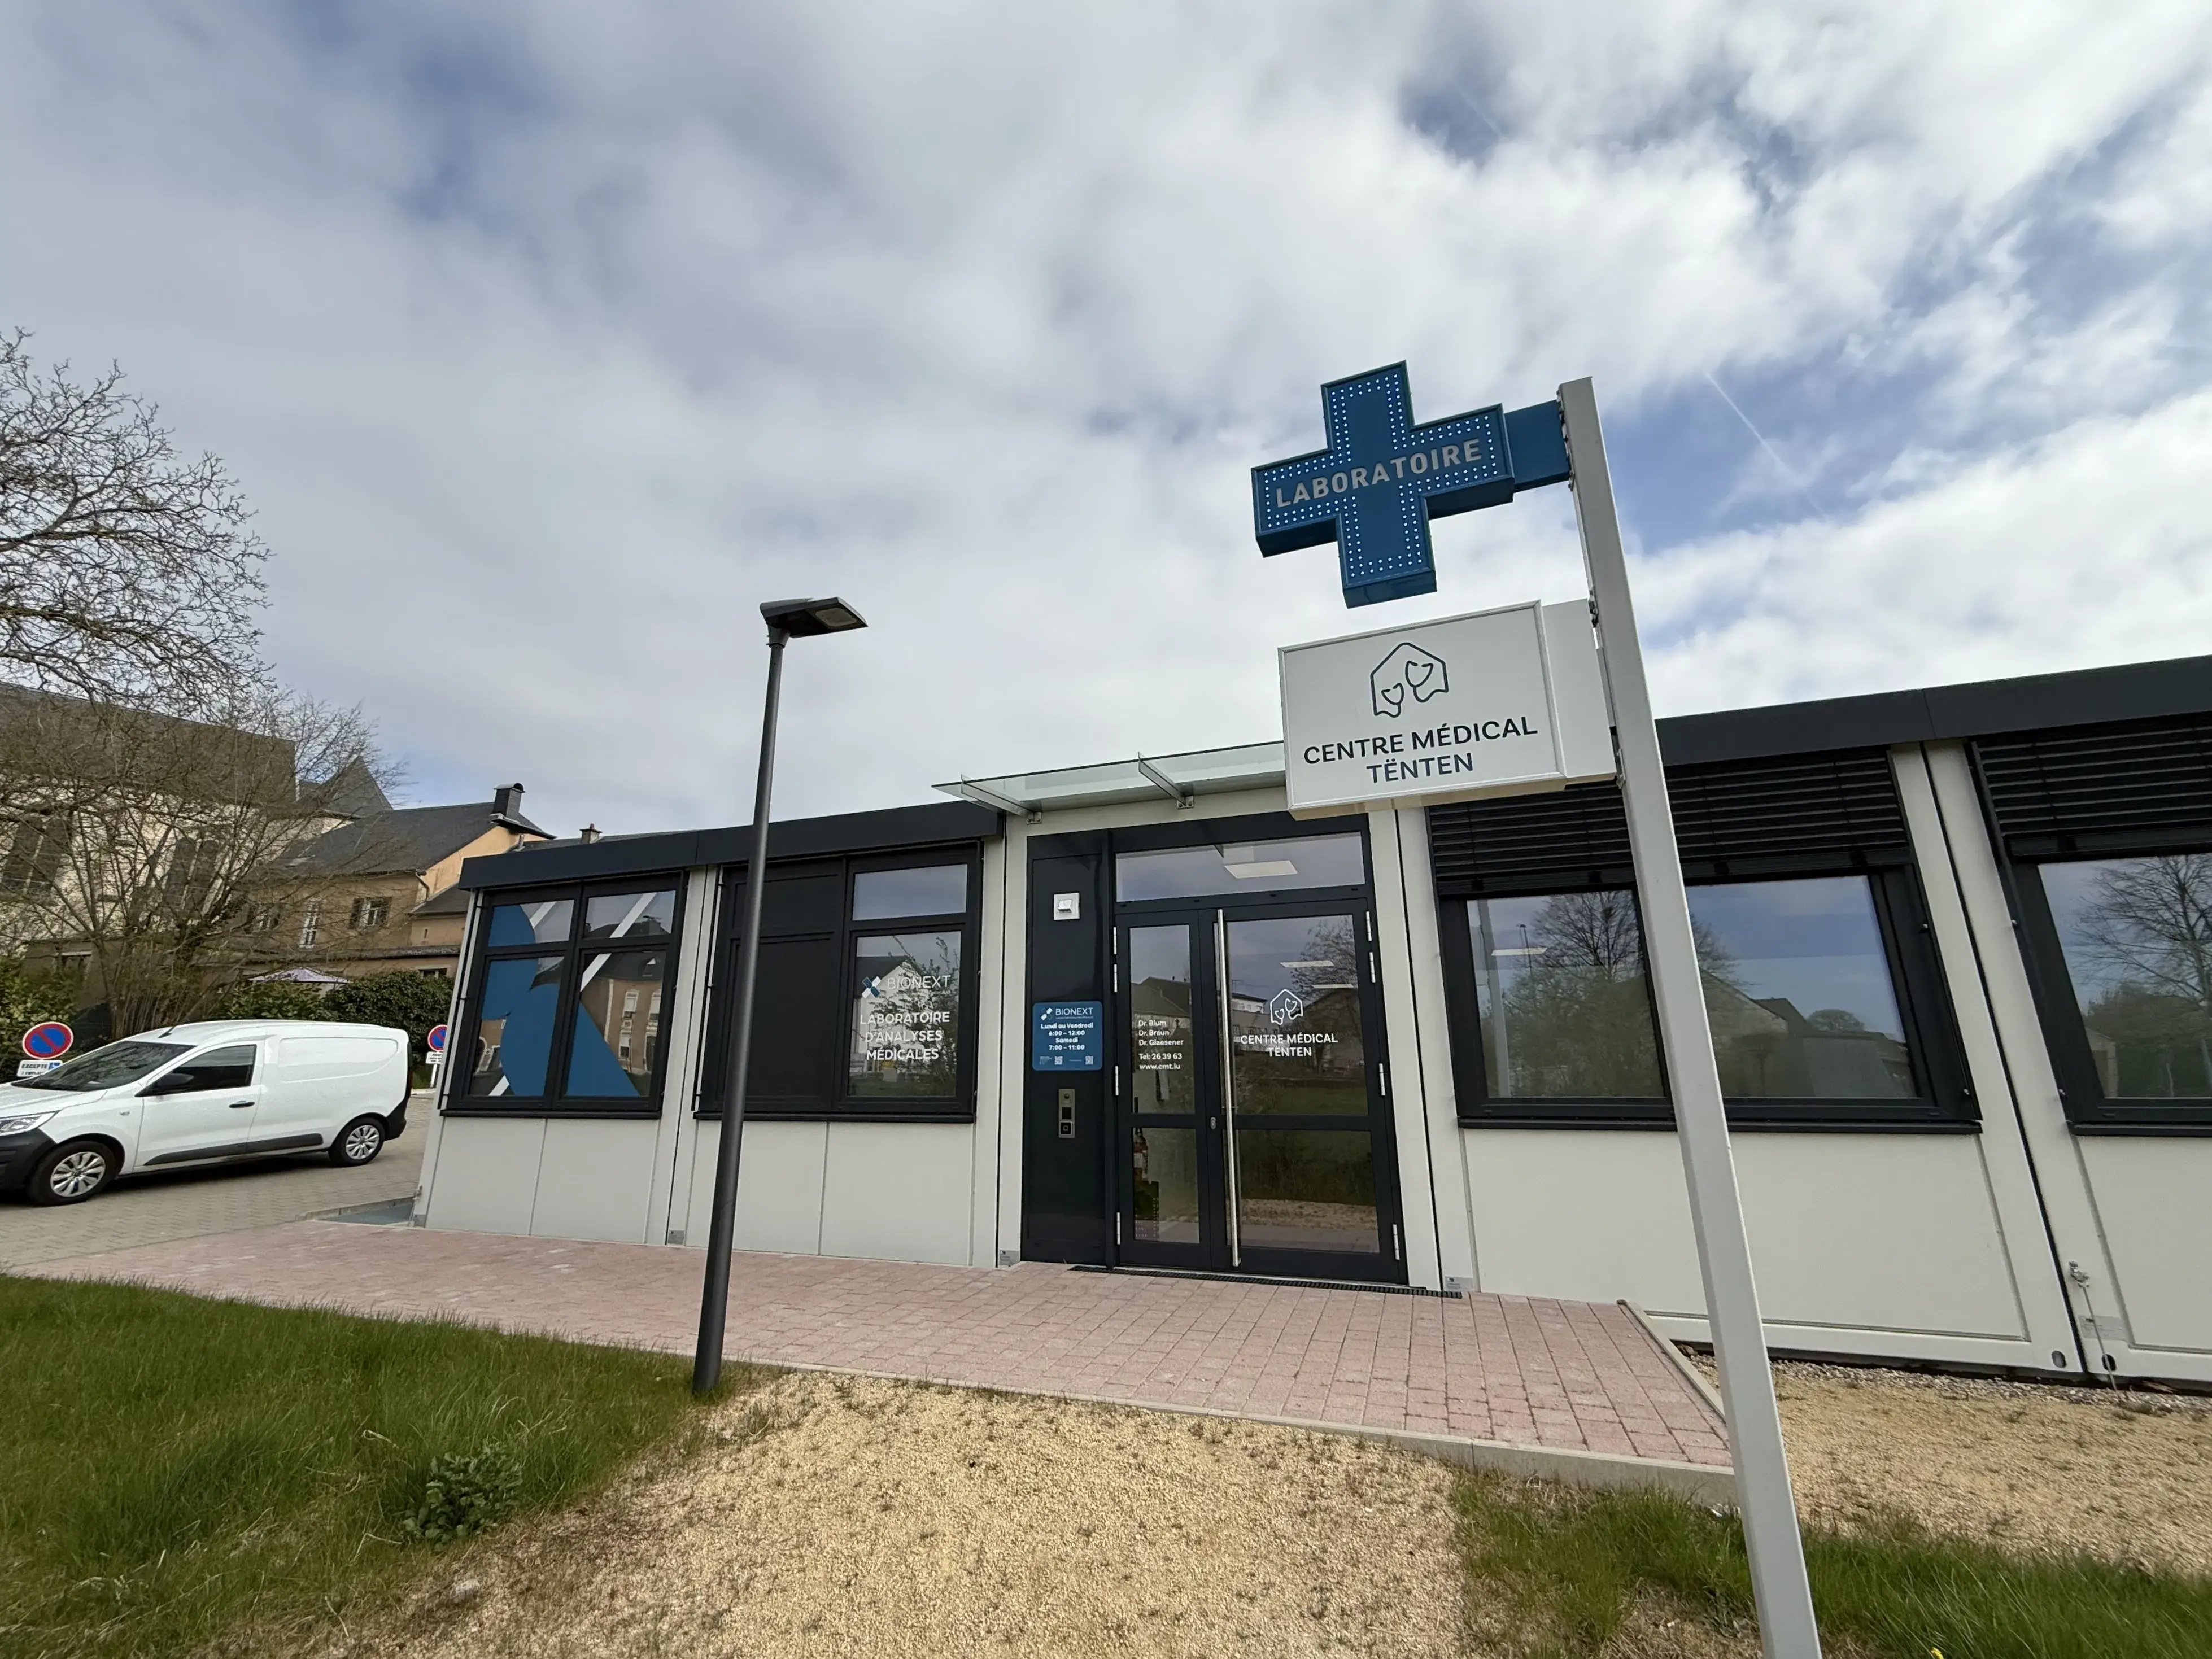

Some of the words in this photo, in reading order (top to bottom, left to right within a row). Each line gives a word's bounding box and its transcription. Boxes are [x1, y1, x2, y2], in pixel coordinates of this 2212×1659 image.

[1276, 438, 1482, 508] LABORATOIRE
[1304, 734, 1404, 765] CENTRE
[1412, 716, 1538, 751] MÉDICAL
[1367, 752, 1474, 784] TËNTEN
[888, 975, 952, 989] BIONEXT
[860, 1011, 950, 1025] LABORATOIRE
[865, 1030, 944, 1043] D'ANALYSES
[1241, 1034, 1284, 1045] CENTRE
[1286, 1032, 1338, 1044] MÉDICAL
[867, 1047, 939, 1060] MÉDICALES
[1267, 1045, 1312, 1058] TËNTEN
